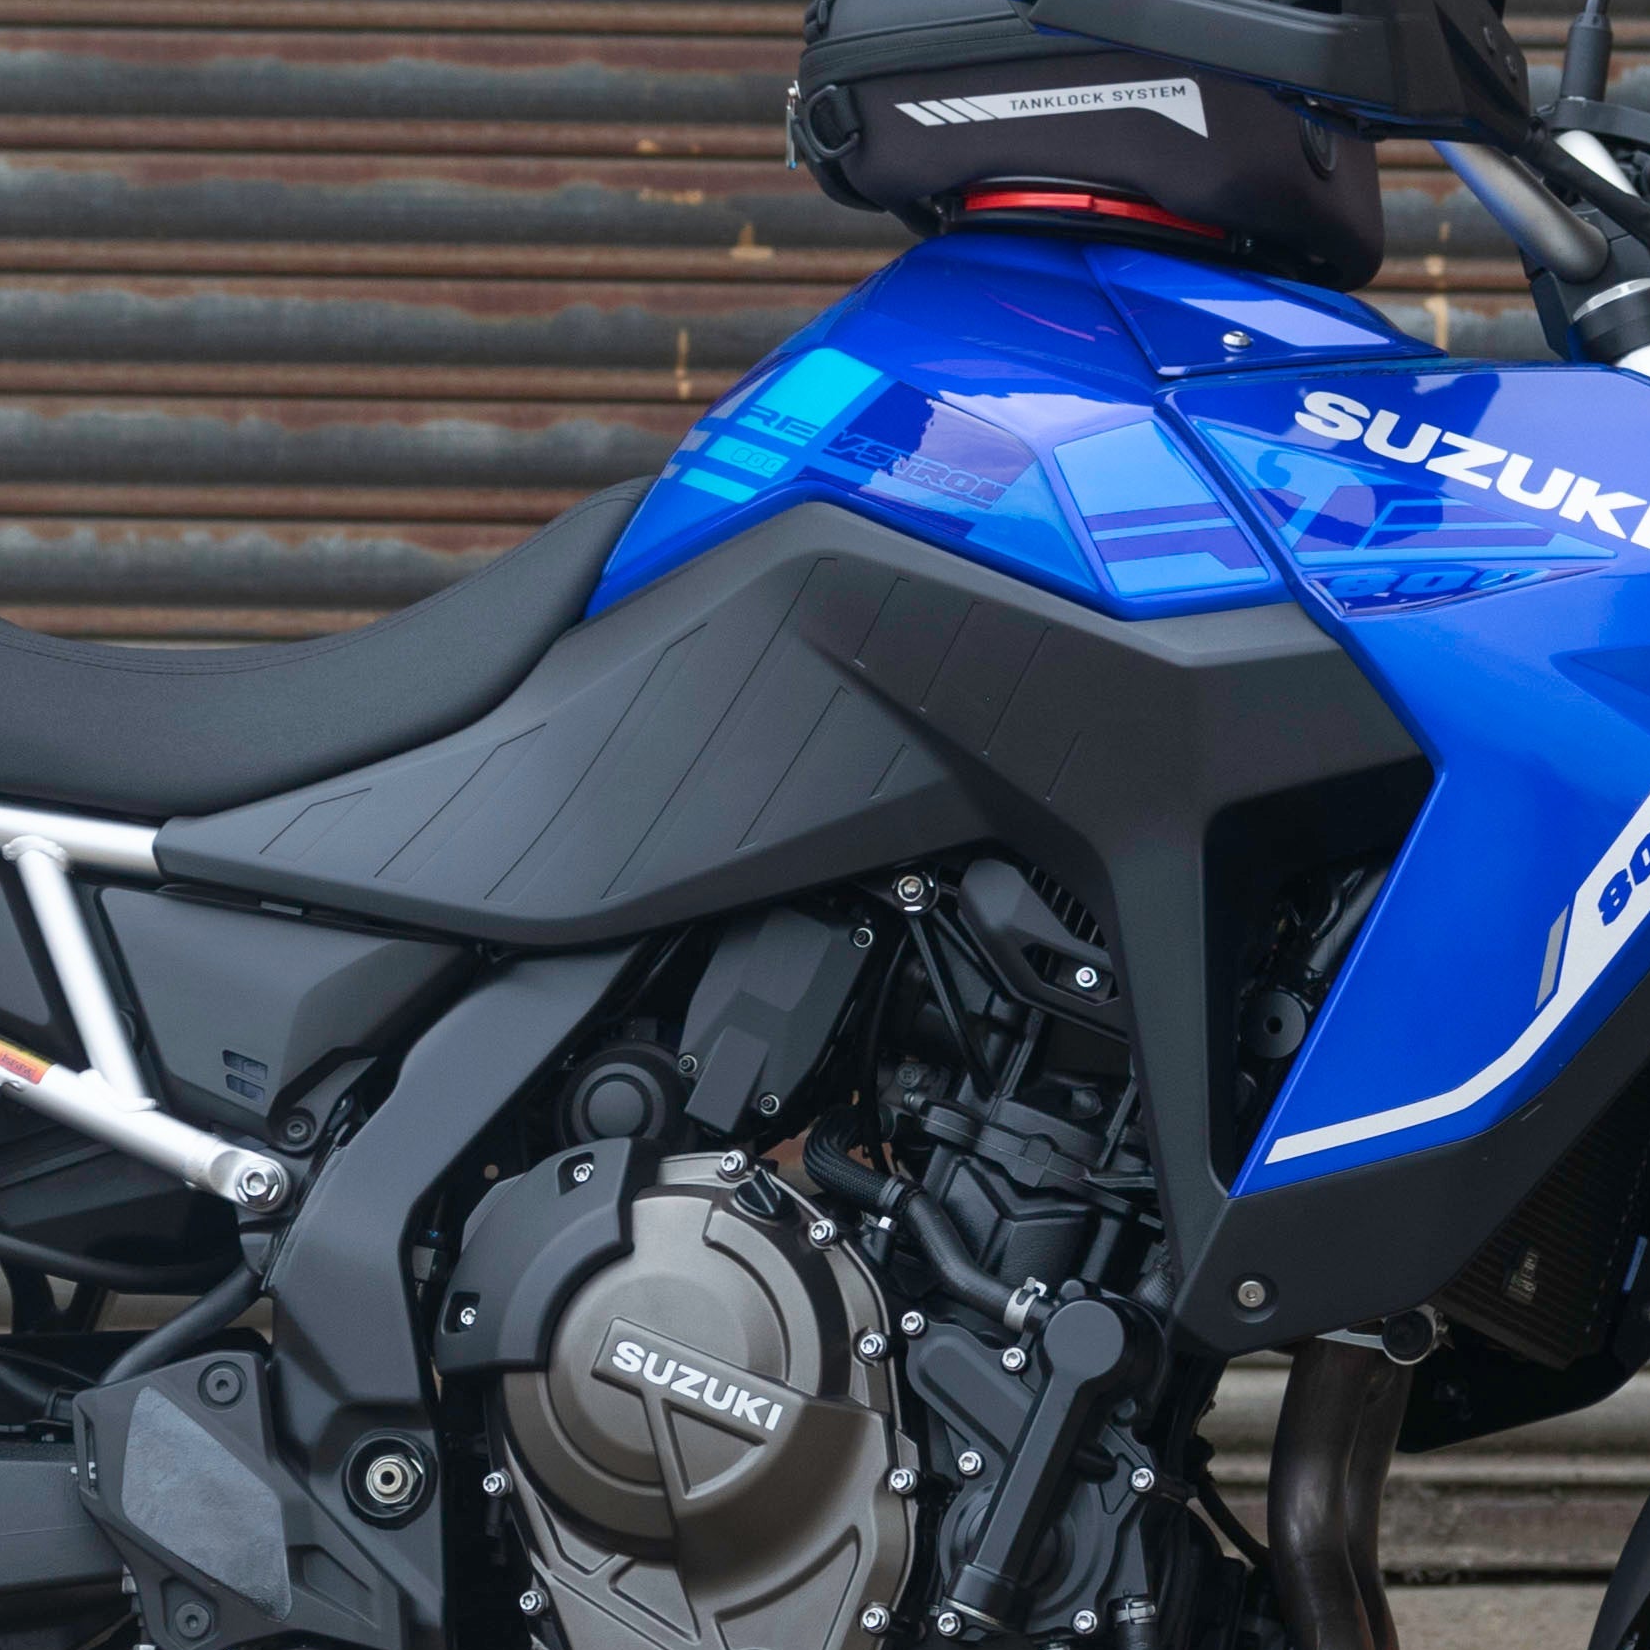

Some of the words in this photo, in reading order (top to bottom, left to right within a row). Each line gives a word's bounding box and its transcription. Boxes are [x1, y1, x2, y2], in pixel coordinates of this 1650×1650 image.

[1009, 92, 1105, 111] TANKLOCK
[1112, 84, 1186, 103] SYSTEM
[825, 429, 1011, 506] V-STROM
[611, 1339, 783, 1431] SUZUKI
